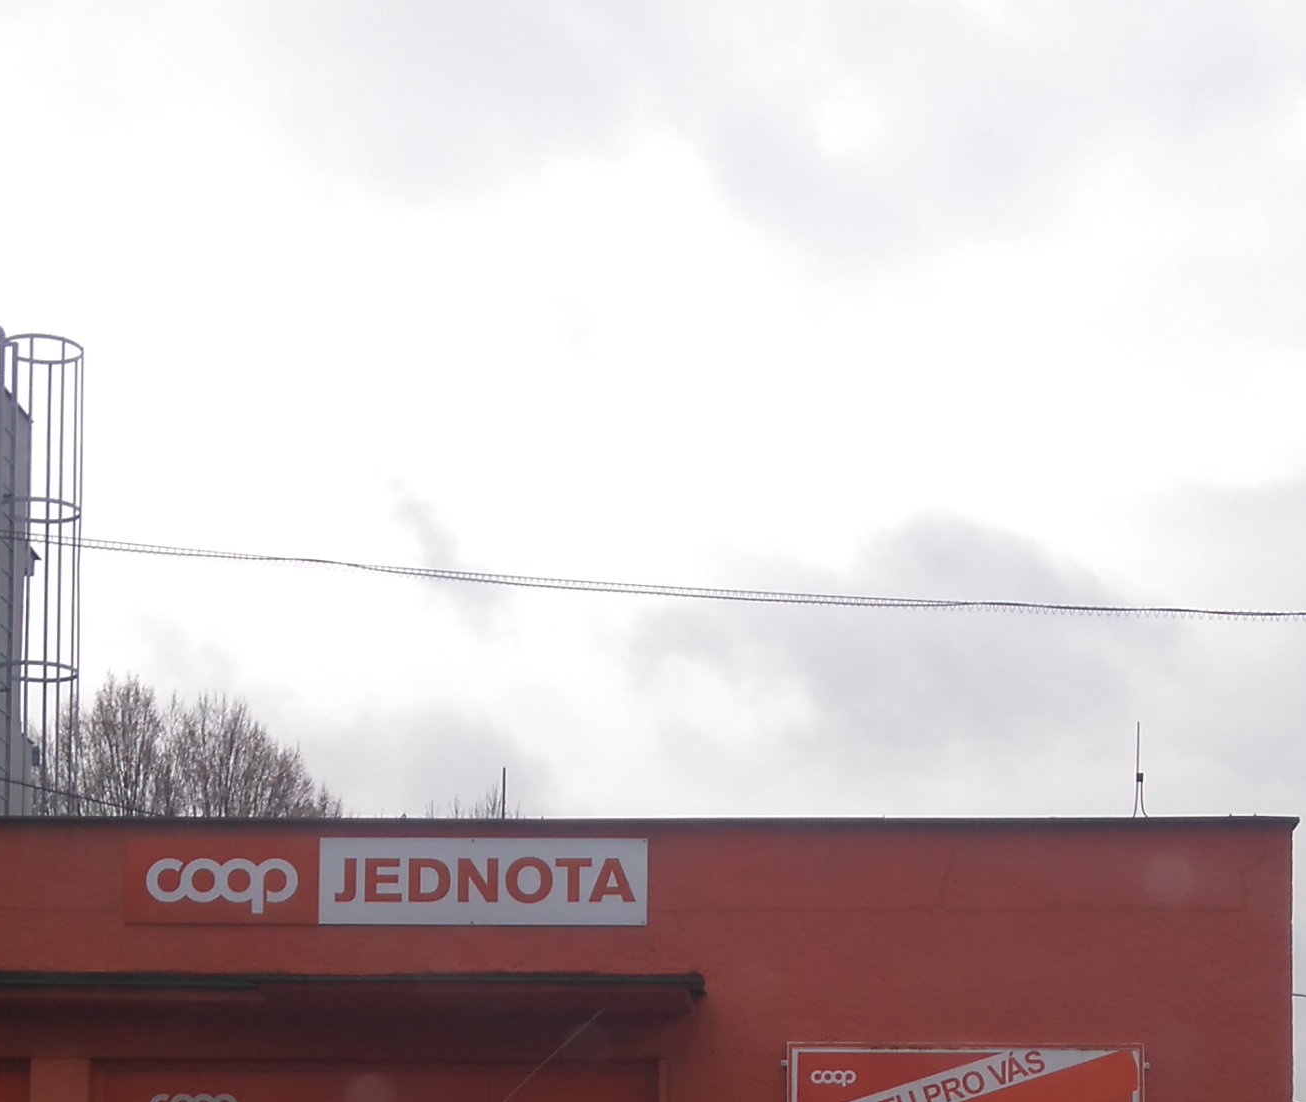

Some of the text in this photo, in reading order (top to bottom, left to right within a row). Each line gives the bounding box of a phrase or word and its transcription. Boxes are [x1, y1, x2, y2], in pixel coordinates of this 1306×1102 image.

[146, 857, 636, 914] coop JEDNOTA
[811, 1069, 856, 1086] coop
[988, 1050, 1046, 1085] VÁS
